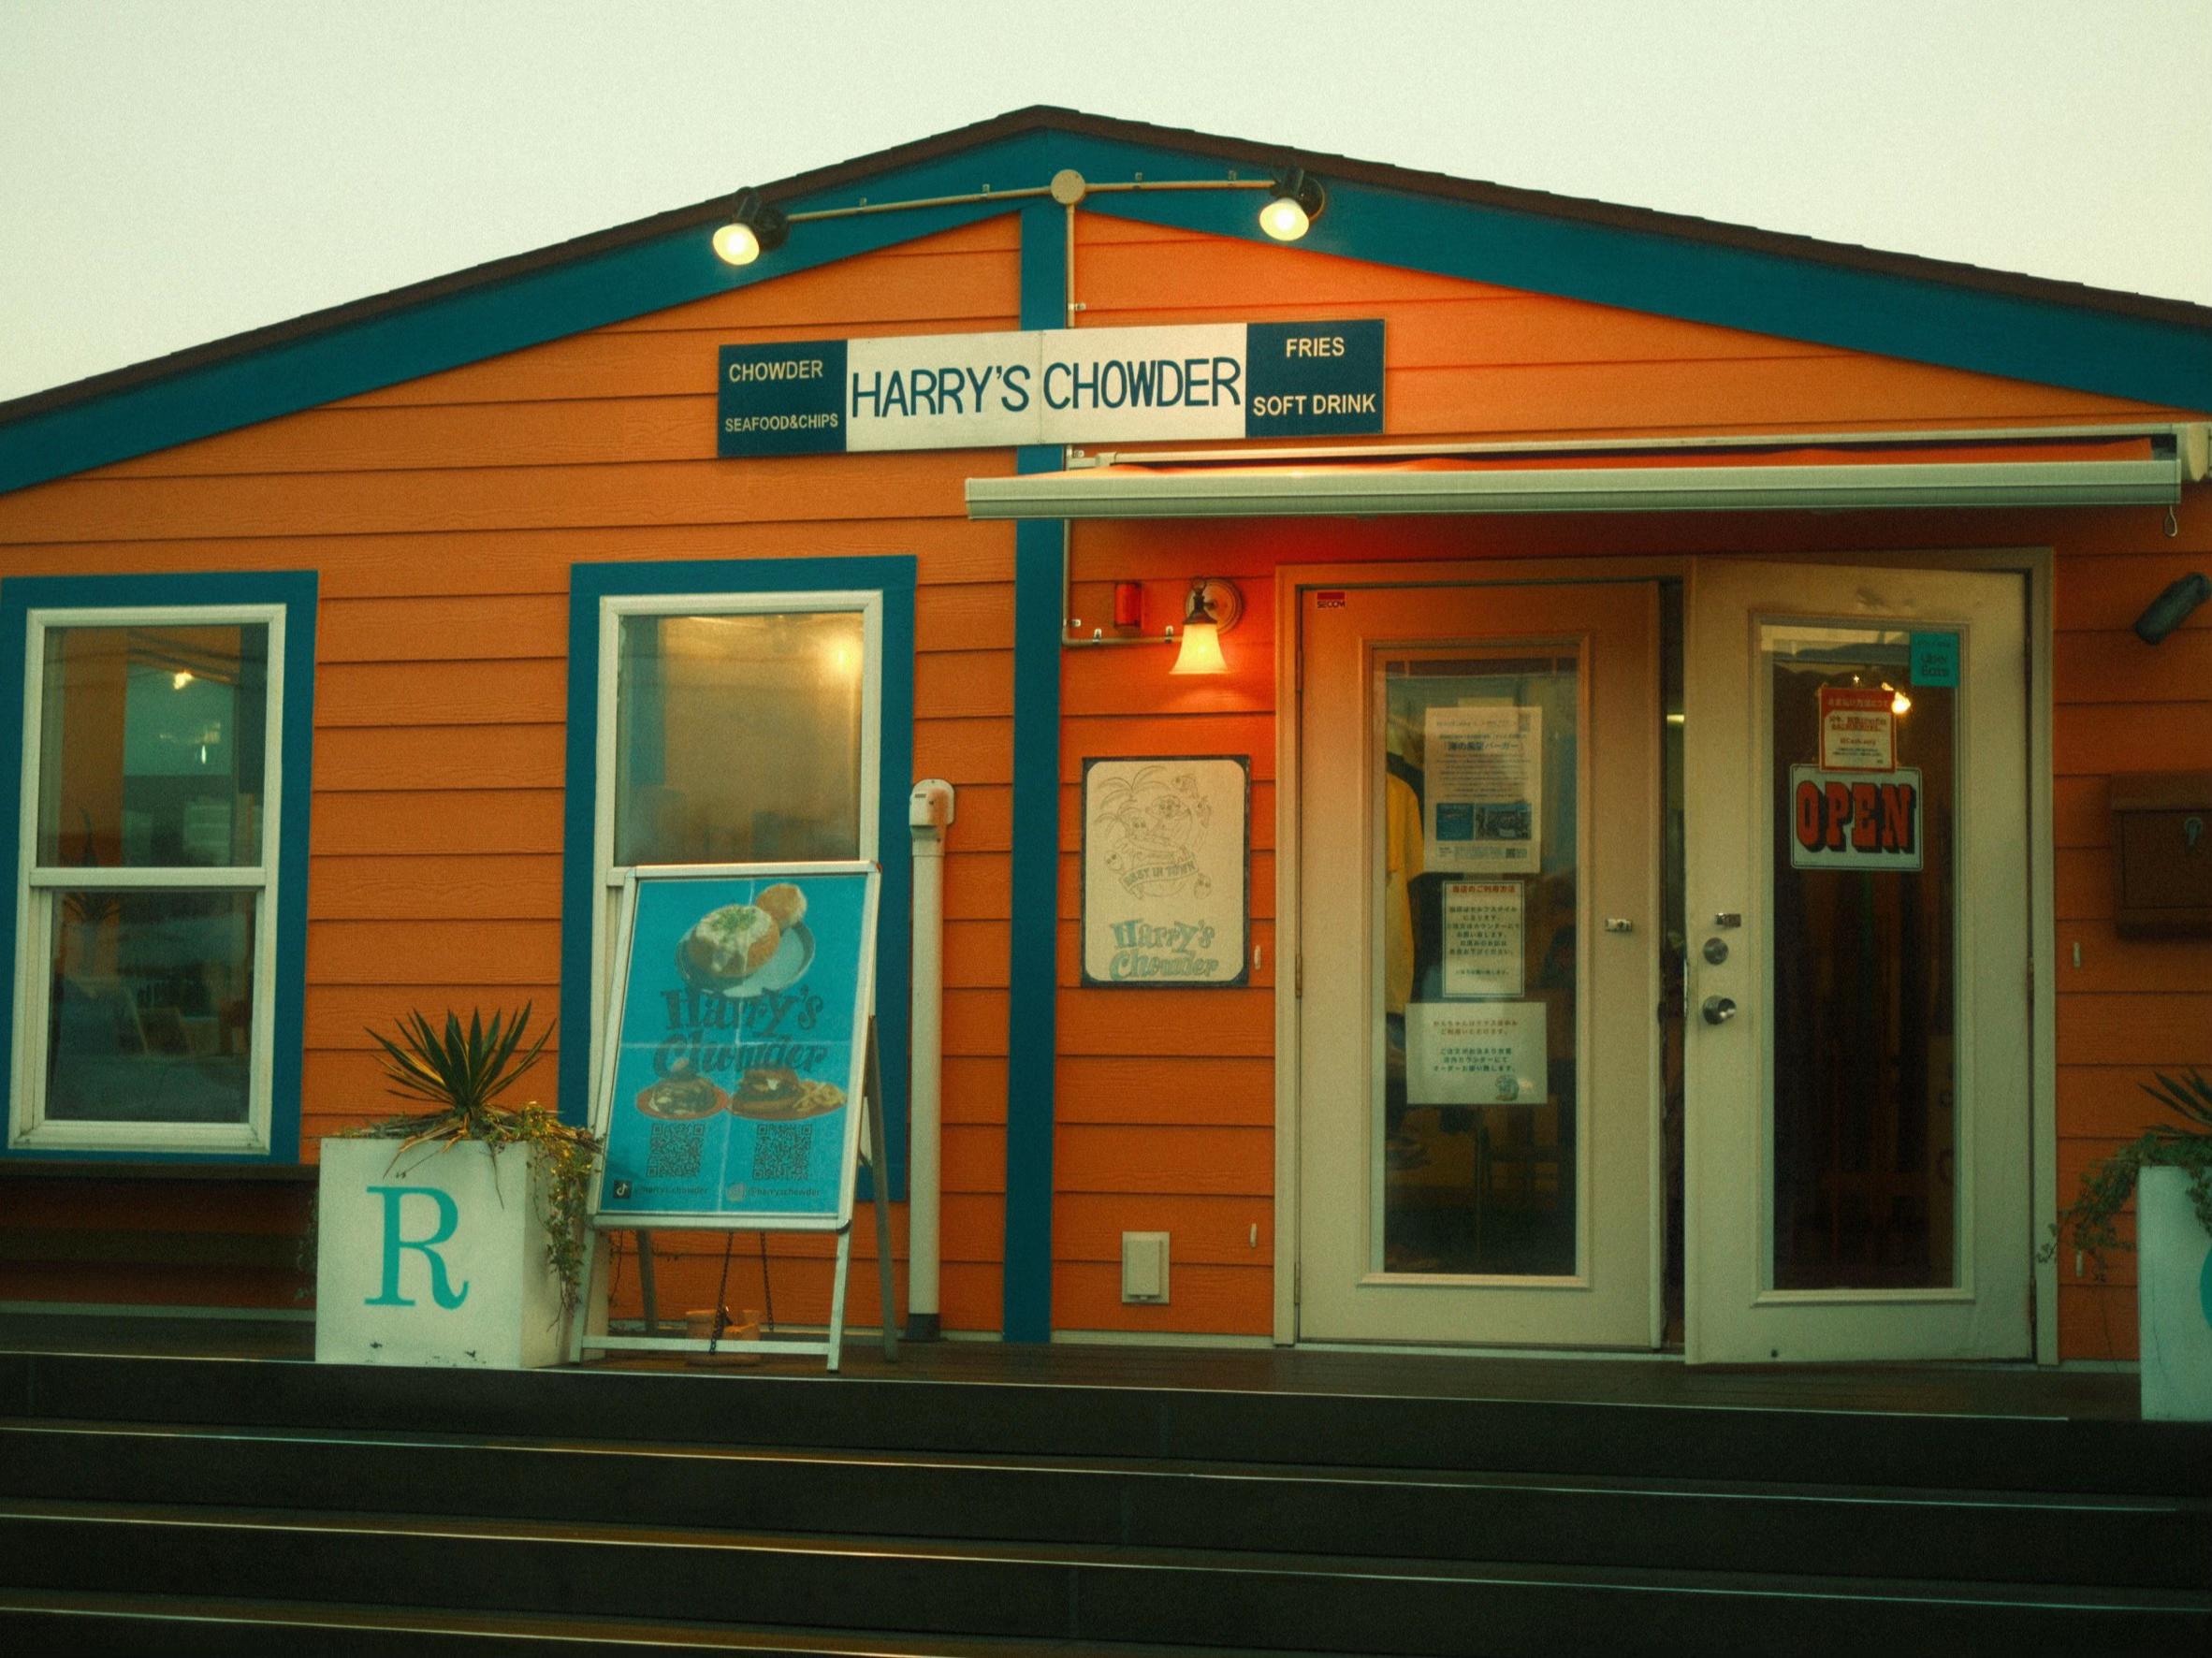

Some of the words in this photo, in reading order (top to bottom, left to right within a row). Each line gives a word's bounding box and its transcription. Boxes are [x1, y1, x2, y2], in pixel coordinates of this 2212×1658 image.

[1286, 337, 1345, 358] FRIES
[728, 359, 823, 383] CHOWDER
[851, 364, 1030, 418] HARRY'S
[1042, 356, 1242, 411] CHOWDER
[1252, 394, 1306, 417] SOFT
[1312, 393, 1376, 415] DRINK
[724, 413, 838, 433] SEAFOOD&CHIPS
[1317, 600, 1346, 608] SECOM
[1795, 779, 1916, 853] OPEN
[1109, 918, 1215, 954] Harry's
[1108, 950, 1219, 982] Chowder
[661, 982, 824, 1038] Harry's
[652, 1029, 828, 1078] Chowder
[364, 1185, 470, 1311] R
